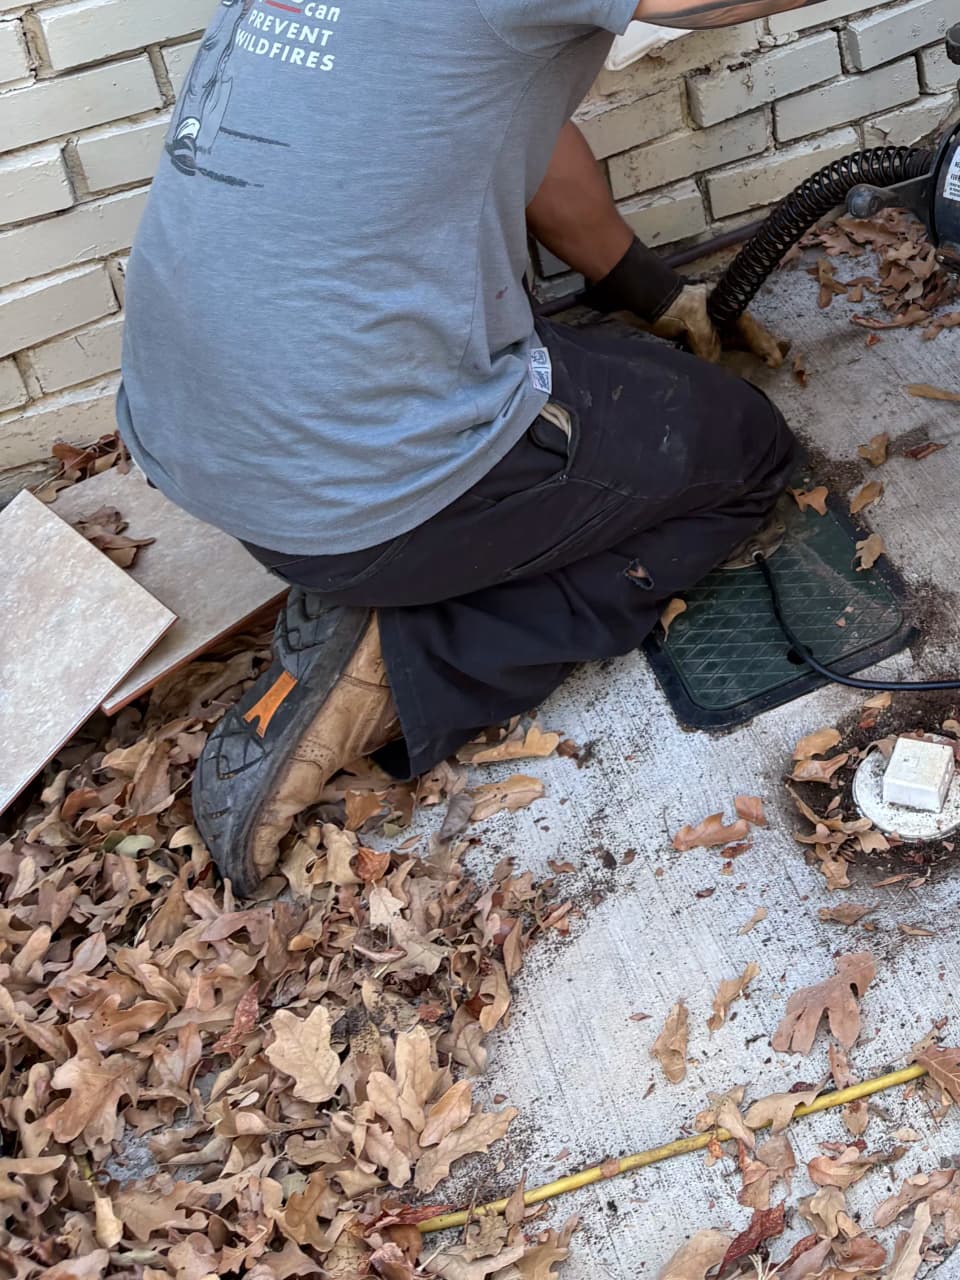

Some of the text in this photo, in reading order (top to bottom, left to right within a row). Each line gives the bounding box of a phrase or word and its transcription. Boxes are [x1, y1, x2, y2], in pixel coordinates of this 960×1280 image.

[248, 9, 333, 46] PREVENT
[304, 2, 341, 22] can
[235, 28, 336, 71] WILDFIRES
